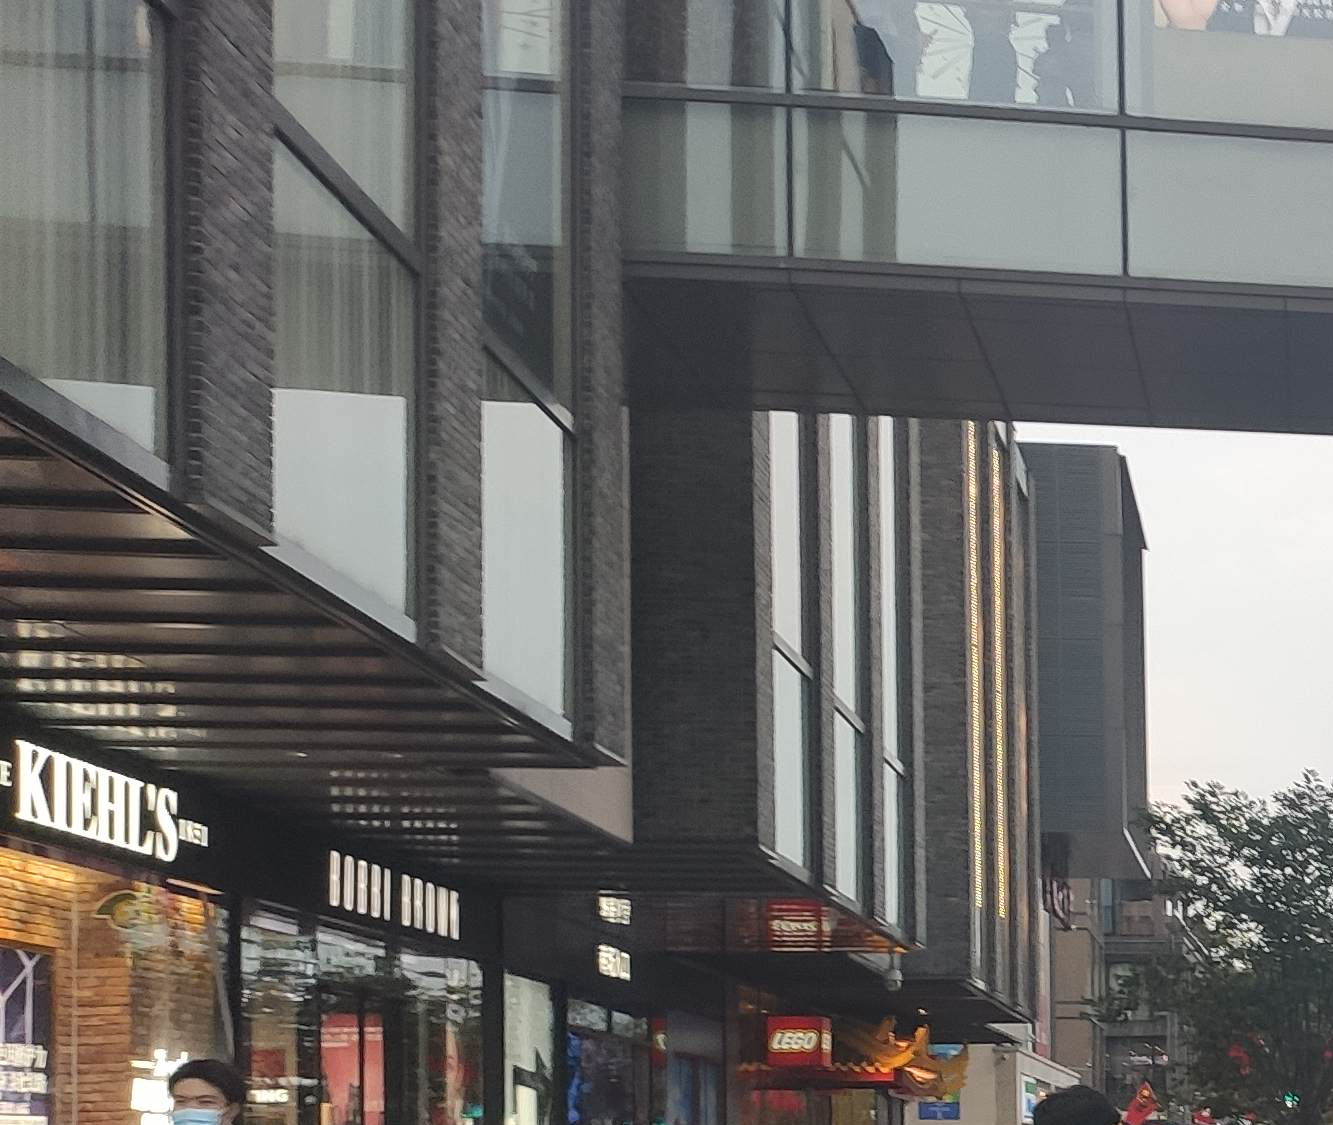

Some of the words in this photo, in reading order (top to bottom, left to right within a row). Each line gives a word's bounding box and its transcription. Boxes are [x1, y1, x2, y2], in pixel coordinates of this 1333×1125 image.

[14, 739, 178, 862] KIEHL'S
[329, 850, 391, 921] BOBBI
[401, 874, 459, 940] BROWN
[770, 1030, 819, 1052] LEGO
